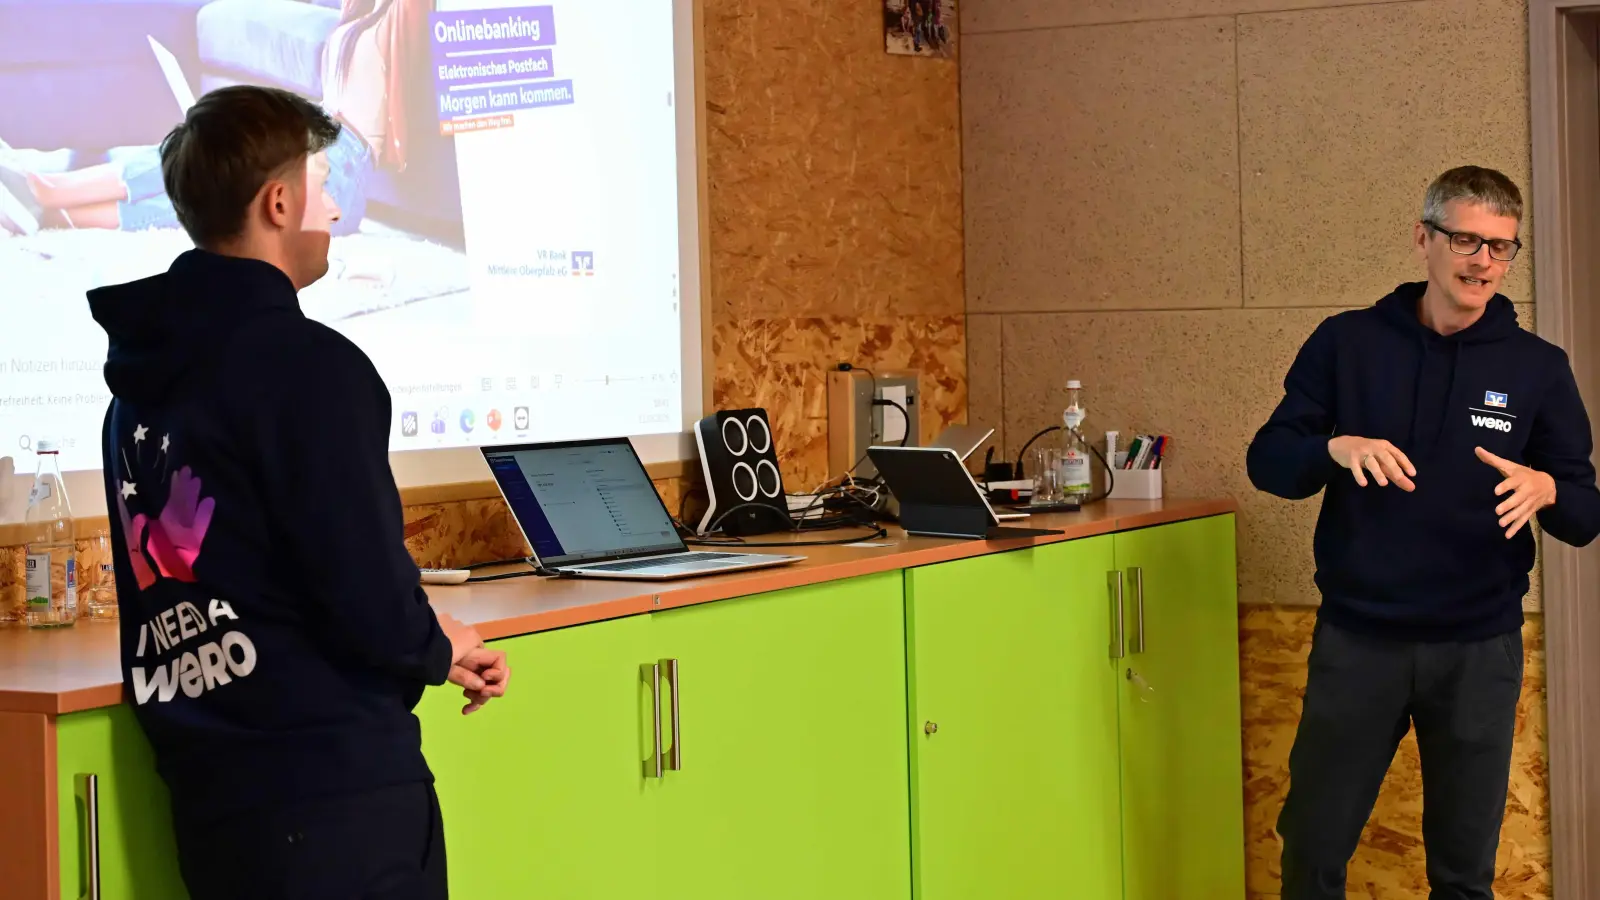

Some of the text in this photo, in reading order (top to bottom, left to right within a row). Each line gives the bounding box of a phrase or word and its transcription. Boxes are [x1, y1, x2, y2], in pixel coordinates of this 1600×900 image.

[435, 17, 540, 43] Onlinebanking
[438, 57, 548, 80] Elektronisches Postfach
[440, 86, 571, 115] Morgen kann kommen.
[537, 249, 567, 260] VR Bank
[519, 264, 555, 278] Oberpfalz
[557, 266, 568, 276] eG
[10, 358, 57, 374] Notizen
[47, 396, 72, 406] Keine
[136, 598, 239, 657] I NEED A
